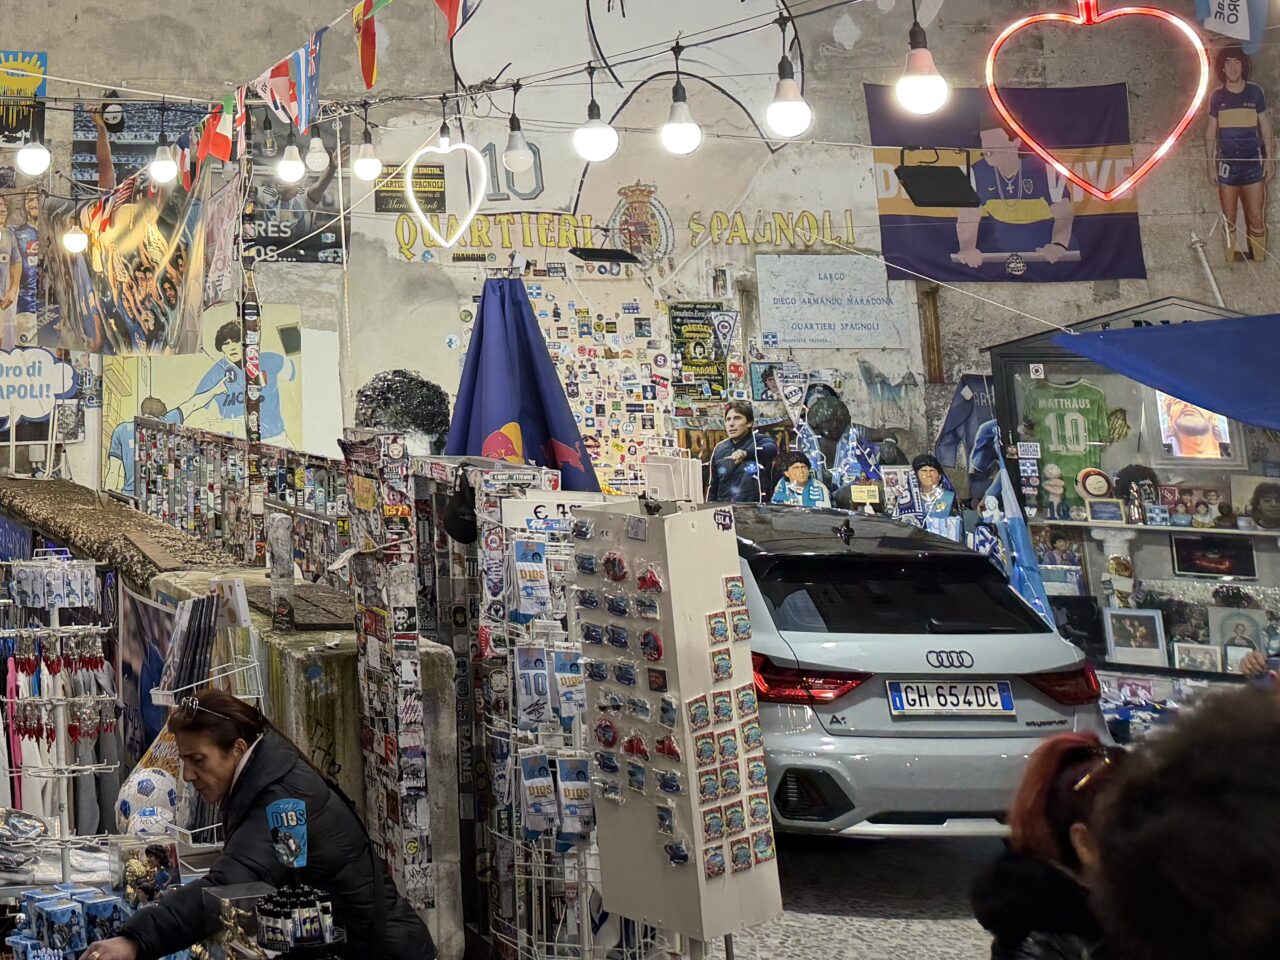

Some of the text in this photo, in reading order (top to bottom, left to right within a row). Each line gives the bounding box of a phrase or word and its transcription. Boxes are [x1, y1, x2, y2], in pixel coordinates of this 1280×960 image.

[481, 141, 545, 201] 10
[395, 209, 855, 260] QUARTIERI SPAGNOLI
[818, 272, 845, 281] LARGO
[773, 297, 894, 306] DIEGO ARMANDO MARADONA
[840, 322, 880, 331] SPAGNOLI
[27, 361, 42, 377] di
[1045, 412, 1089, 455] 10
[520, 673, 547, 696] 10
[905, 685, 998, 707] GH 654DC
